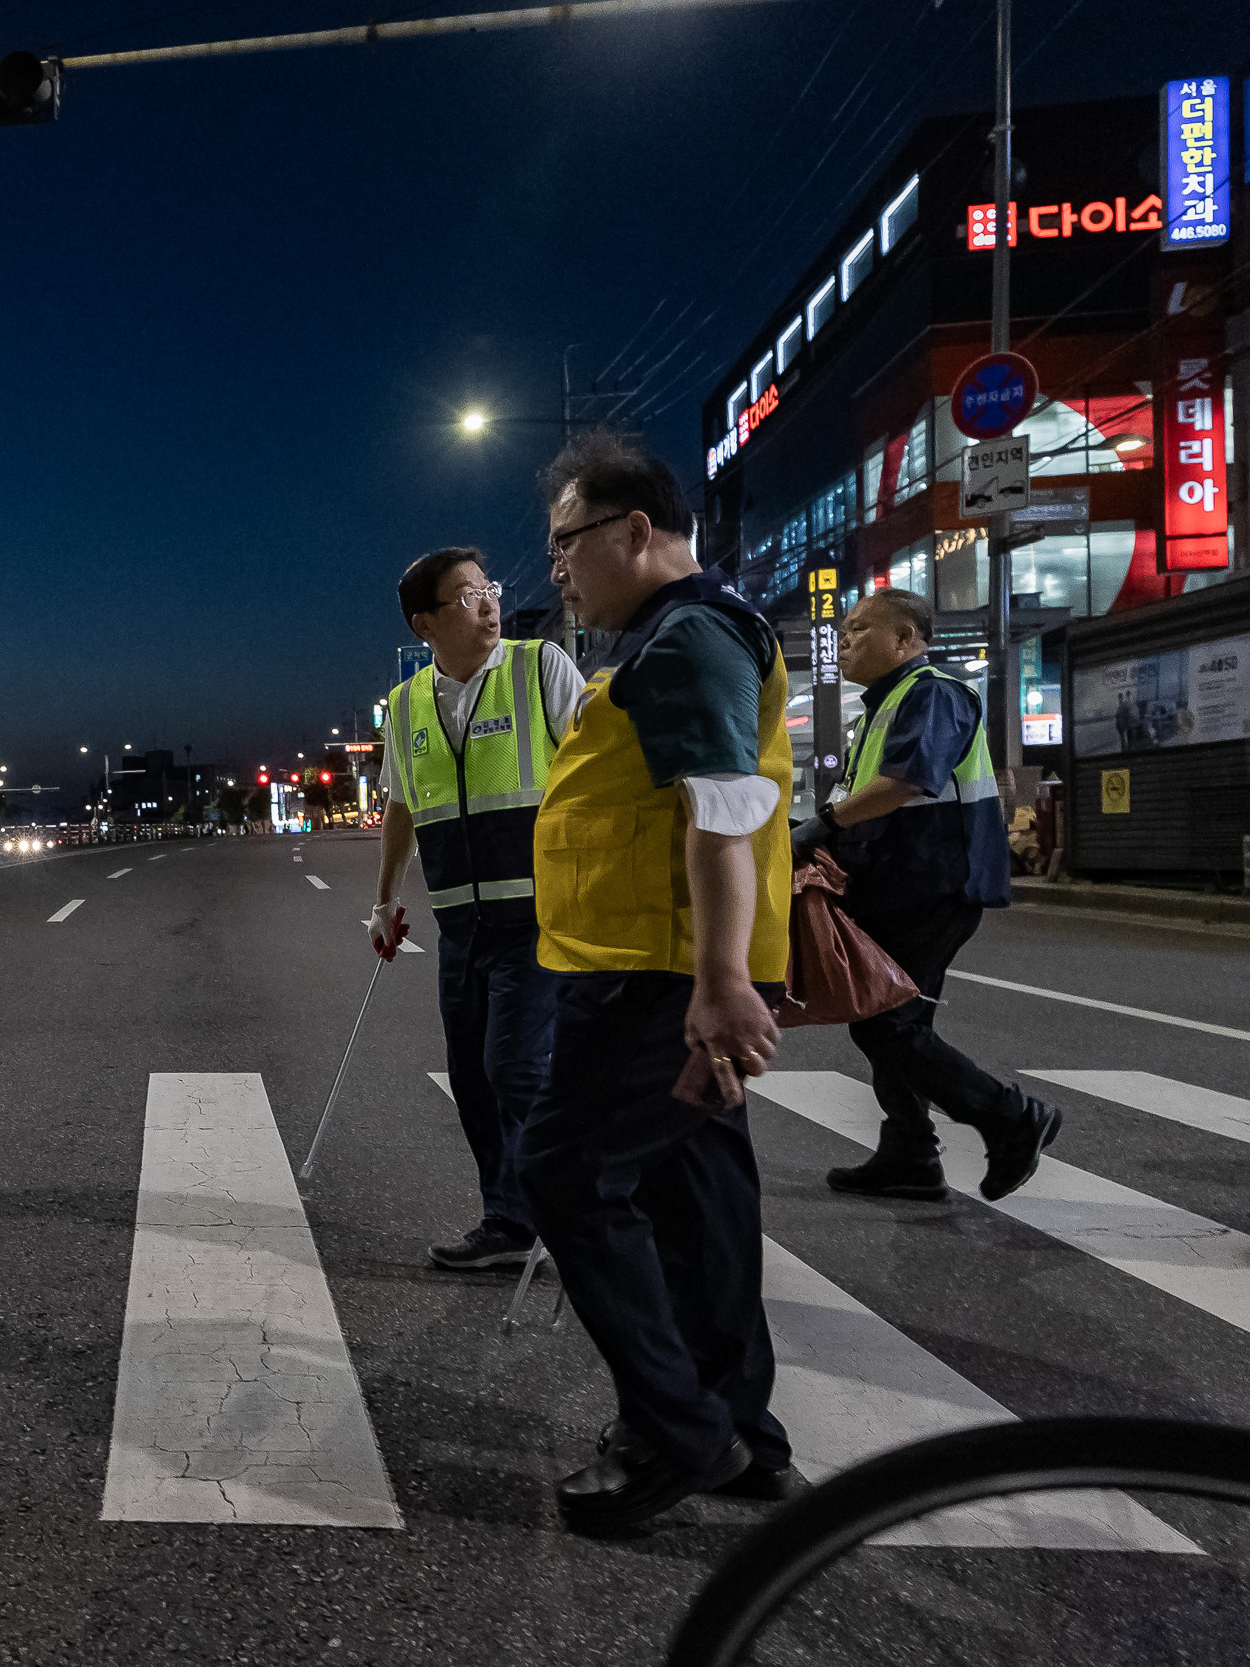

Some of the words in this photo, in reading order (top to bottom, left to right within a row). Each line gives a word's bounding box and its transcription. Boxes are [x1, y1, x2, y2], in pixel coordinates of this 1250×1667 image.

[1179, 79, 1217, 96] 서울
[1029, 194, 1163, 238] 다이소
[750, 384, 779, 431] 다이소
[968, 446, 1024, 471] 견인지역
[822, 593, 834, 610] 2
[818, 623, 833, 664] 아차산
